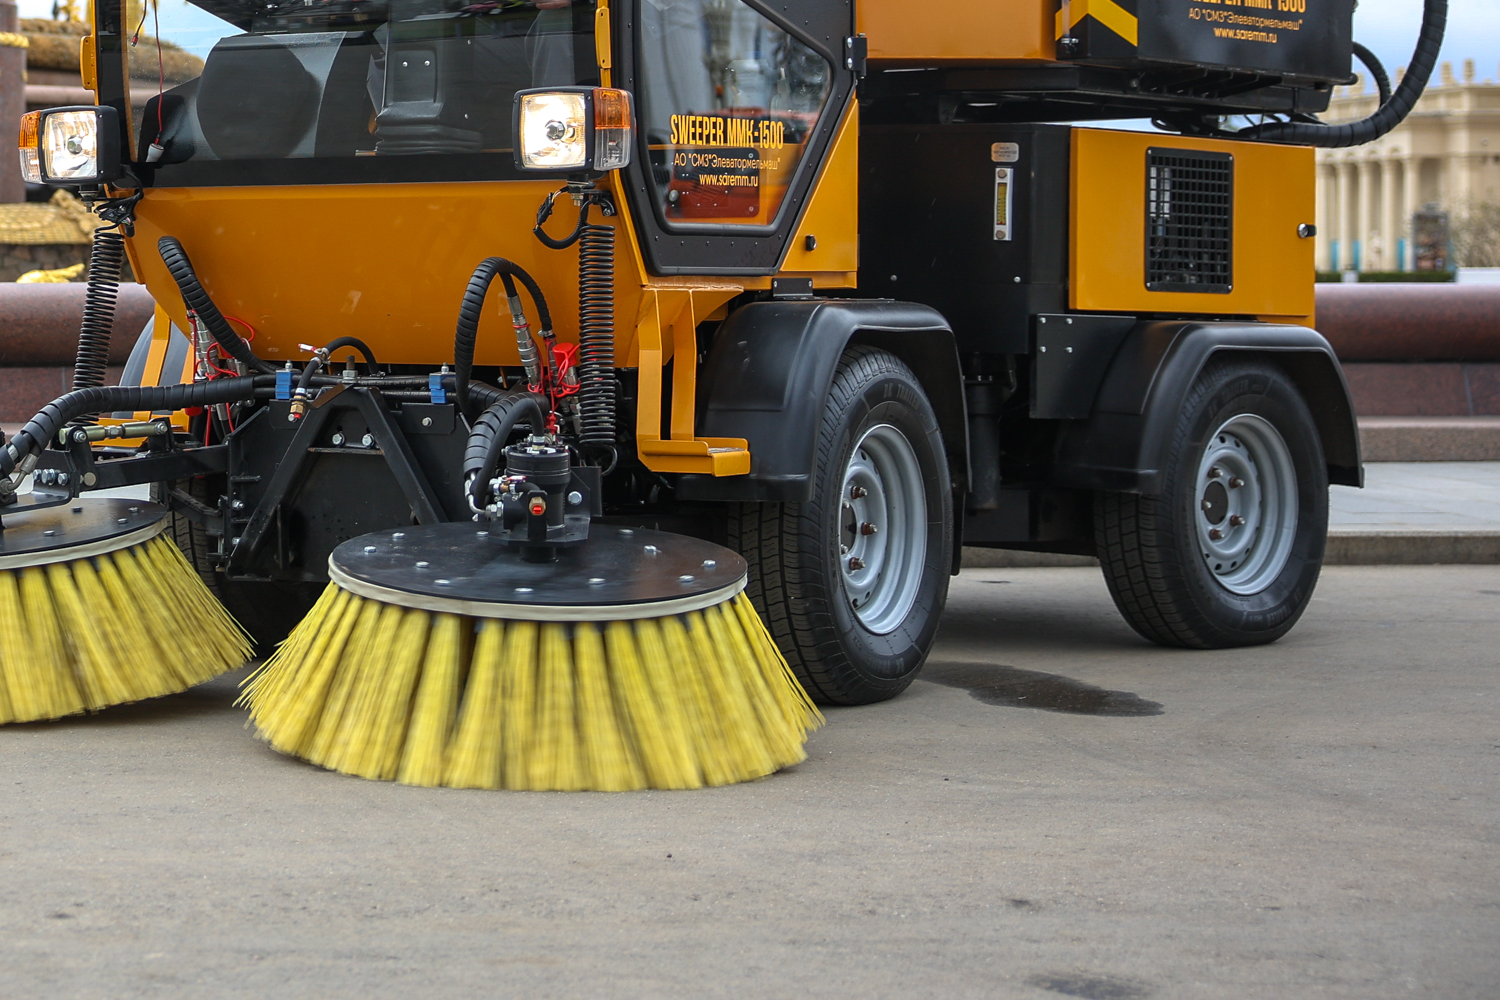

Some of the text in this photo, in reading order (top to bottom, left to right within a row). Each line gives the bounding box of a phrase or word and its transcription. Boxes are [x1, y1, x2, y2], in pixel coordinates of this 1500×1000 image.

[1189, 8, 1201, 20] АО
[1213, 28, 1277, 43] www.saremm.ru
[670, 114, 724, 145] SWEEPER
[674, 153, 687, 167] АО
[699, 174, 758, 187] www.saremm.ru
